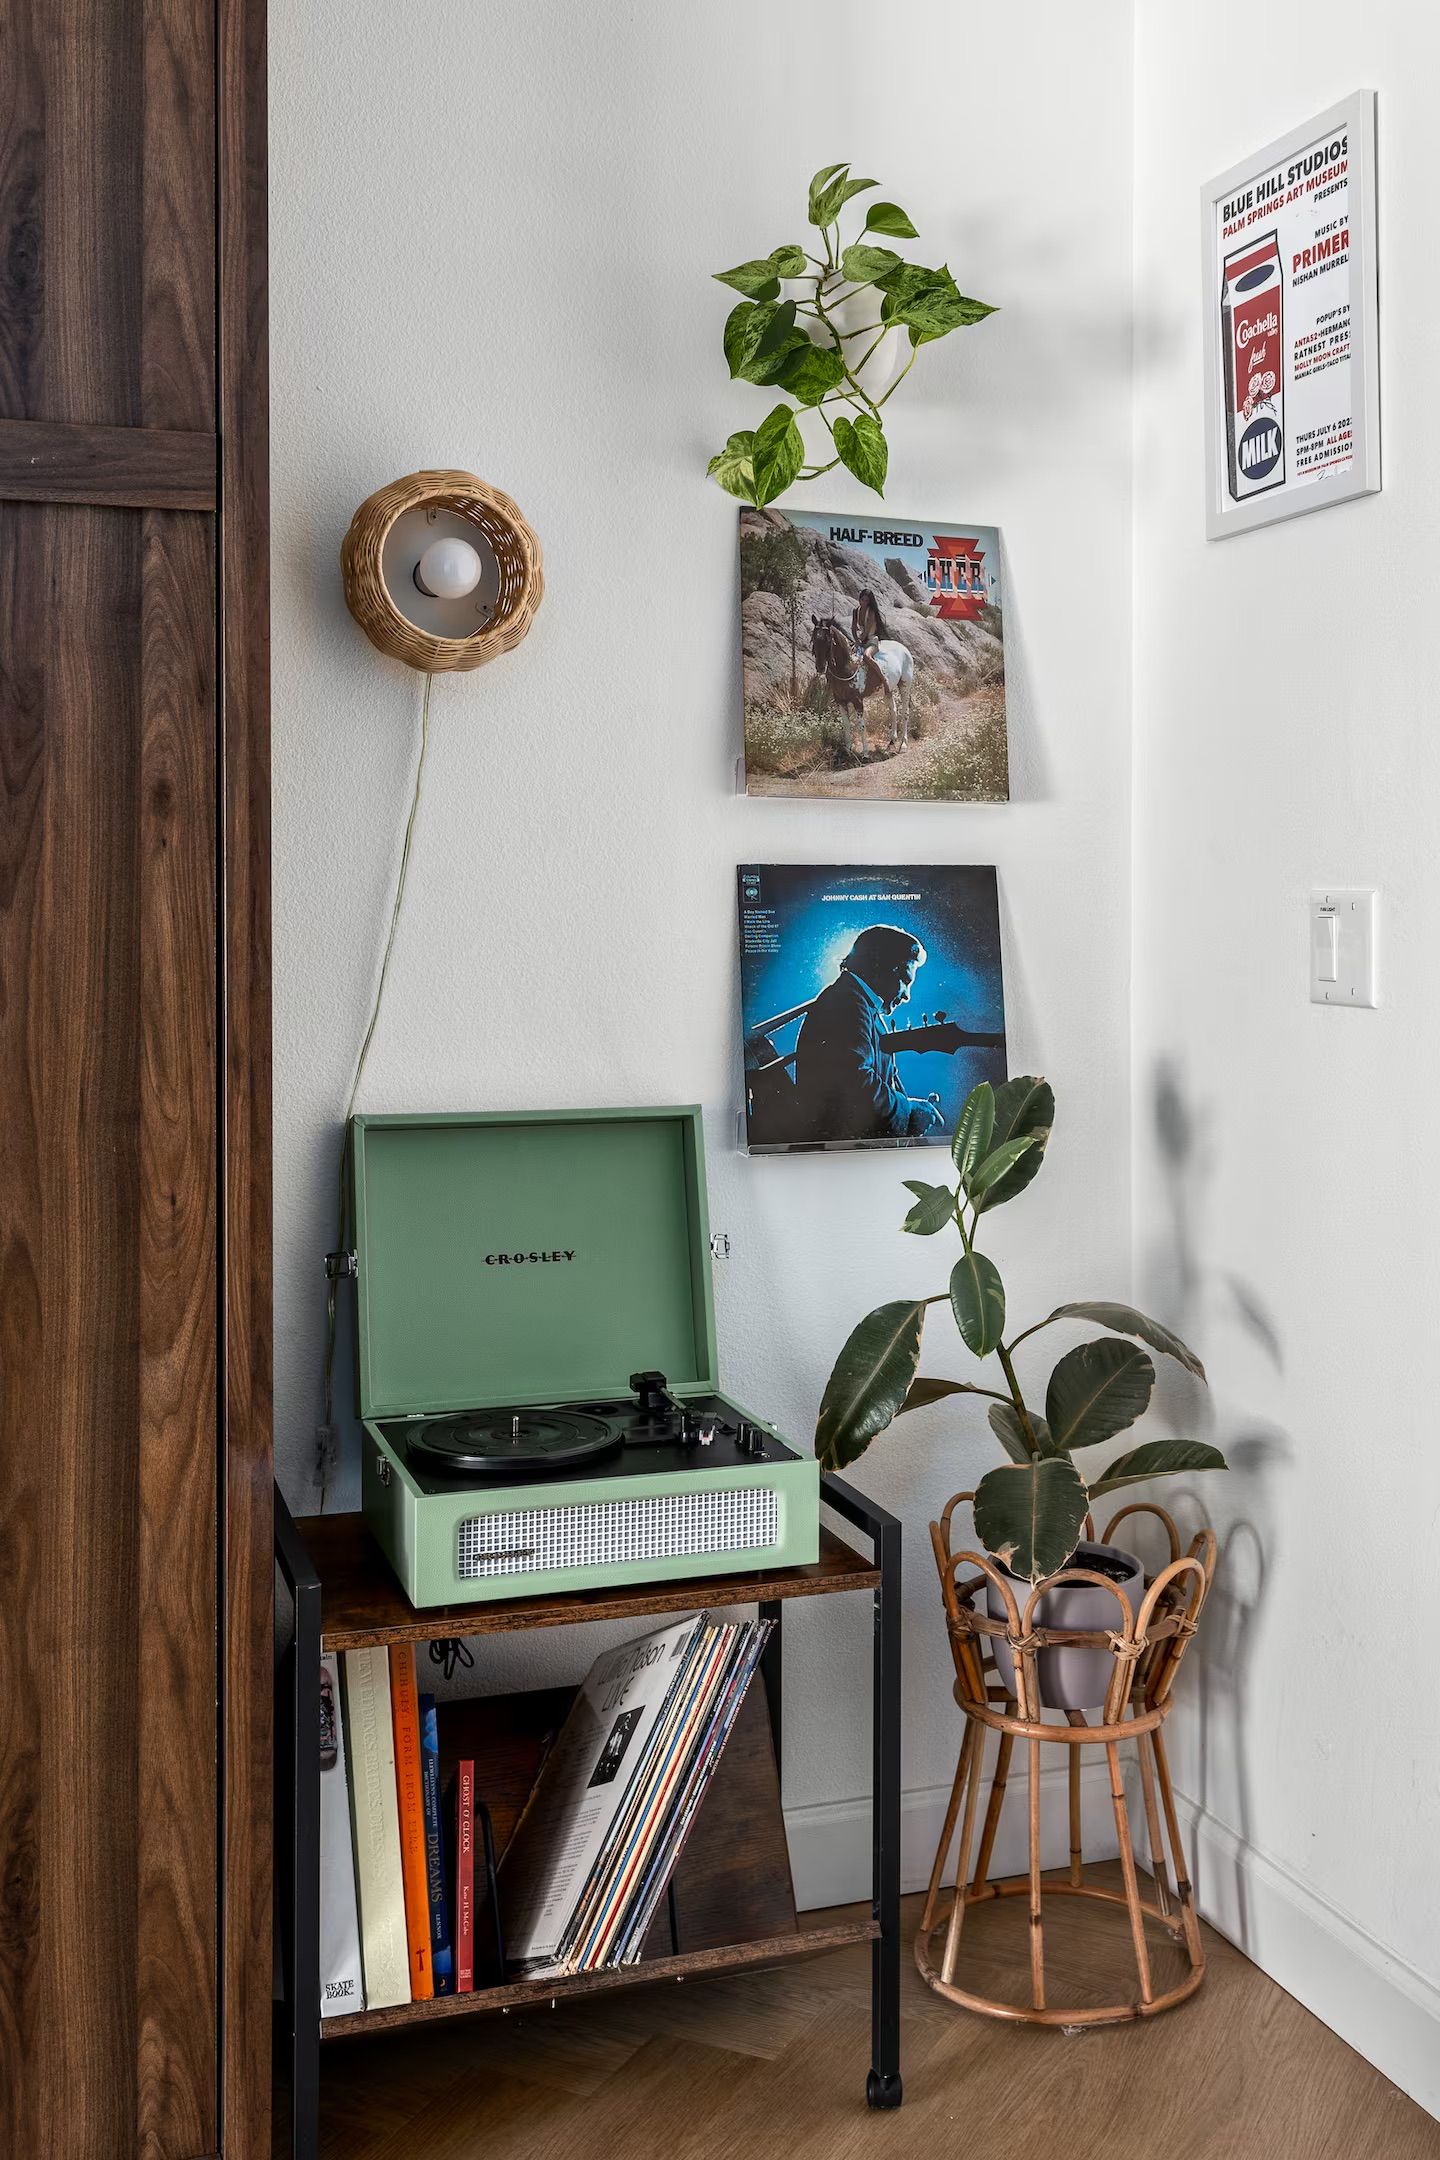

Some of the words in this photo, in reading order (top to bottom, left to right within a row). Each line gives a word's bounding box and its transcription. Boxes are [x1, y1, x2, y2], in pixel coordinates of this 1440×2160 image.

[1223, 190, 1253, 223] BLUE
[1256, 173, 1285, 204] HILL
[1287, 135, 1348, 186] STUDIOS
[1314, 177, 1348, 203] PRESENTS
[1222, 216, 1246, 240] PALM
[1246, 195, 1284, 227] SPRINGS
[1286, 184, 1304, 204] ART
[1306, 159, 1348, 193] MUSEUM
[1314, 219, 1337, 239] MUSIC
[1339, 215, 1349, 229] BY
[1292, 229, 1350, 274] PRIMER
[1292, 269, 1318, 288] NISHAN
[1319, 253, 1350, 275] MURREL
[1316, 307, 1342, 325] POPUP'S
[1342, 304, 1350, 314] BY
[1236, 312, 1278, 349] Coachella
[1294, 340, 1327, 361] RATNEST
[1329, 330, 1351, 346] PRES
[1294, 359, 1312, 372] MOLLY
[1313, 351, 1331, 364] MOON
[1296, 430, 1316, 444] THURS
[1316, 424, 1331, 437] JULY
[1332, 422, 1337, 431] 6
[1337, 417, 1352, 429] 202
[1327, 436, 1337, 446] ALL
[1338, 430, 1352, 441] AGE
[1241, 426, 1280, 471] MILK
[1296, 456, 1312, 468] FREE
[829, 526, 924, 548] HALF-BREED
[821, 894, 849, 902] JOHNNY
[891, 893, 921, 901] QUENTIN
[485, 1250, 576, 1265] CROSLEY
[402, 1727, 414, 1766] FORM
[427, 1833, 443, 1903] DREAMS
[325, 1979, 355, 1992] SKATE
